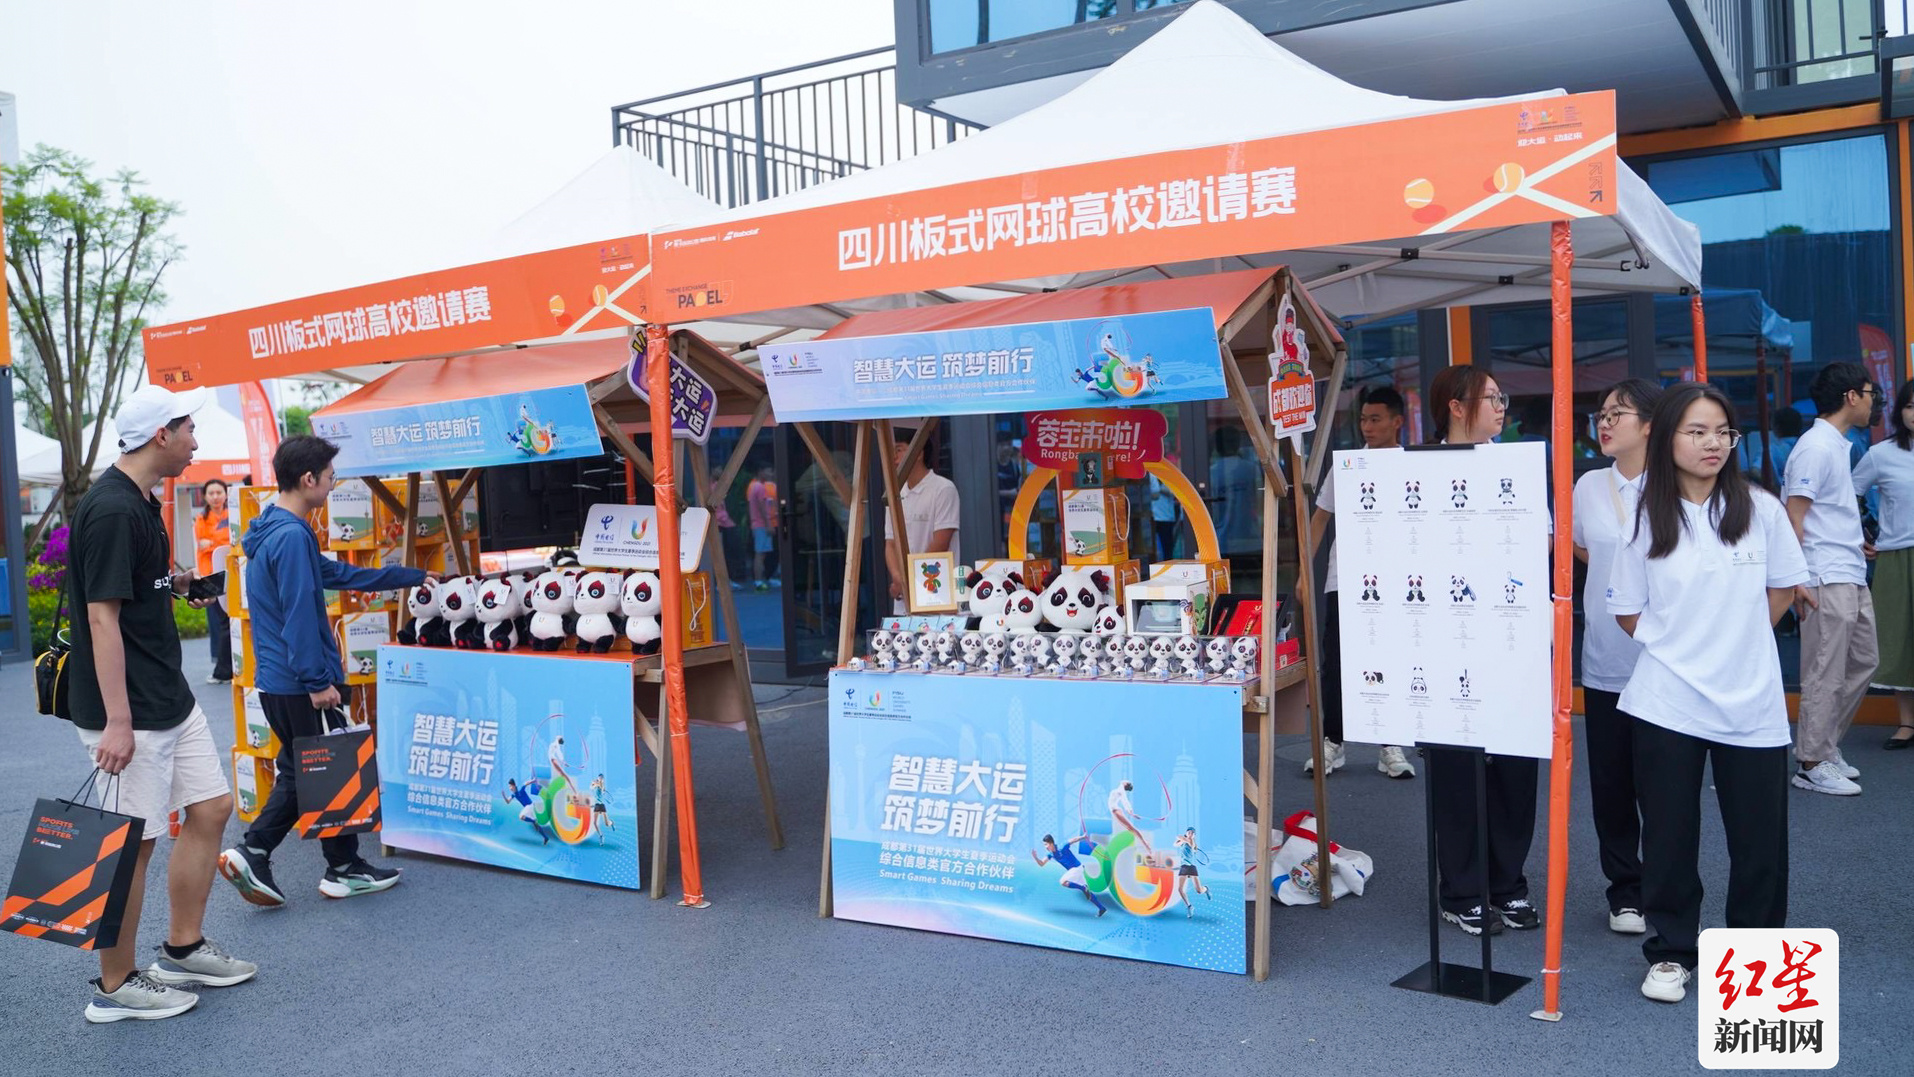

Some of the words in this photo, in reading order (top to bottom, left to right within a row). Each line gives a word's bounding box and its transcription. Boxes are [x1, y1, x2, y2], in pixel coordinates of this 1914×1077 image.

[838, 166, 1297, 271] 四川板式网球高校邀请赛
[248, 286, 492, 359] 四川板式网球高校邀请赛
[854, 354, 937, 384] 智慧大运
[942, 347, 1034, 378] 筑梦前行
[1273, 382, 1313, 415] 成都欢迎你
[371, 422, 423, 447] 智慧大运
[425, 416, 481, 440] 筑梦前行
[412, 712, 499, 752] 智慧大运
[407, 745, 495, 785] 筑梦前行
[888, 754, 1027, 801] 智慧大运
[407, 792, 492, 815] 综合信息类官方合作伙伴
[407, 805, 424, 814] Smart
[424, 808, 444, 817] Games
[446, 811, 468, 823] Sharing
[468, 816, 492, 826] Dreams
[880, 794, 1021, 843] 筑梦前行
[879, 852, 1015, 880] 综合信息类官方合作伙伴
[881, 840, 1016, 865] 成都第31届世界大学生夏季运动会
[879, 869, 906, 880] Smart
[907, 872, 937, 884] Games
[941, 876, 976, 891] Sharing
[977, 880, 1014, 894] Dreams
